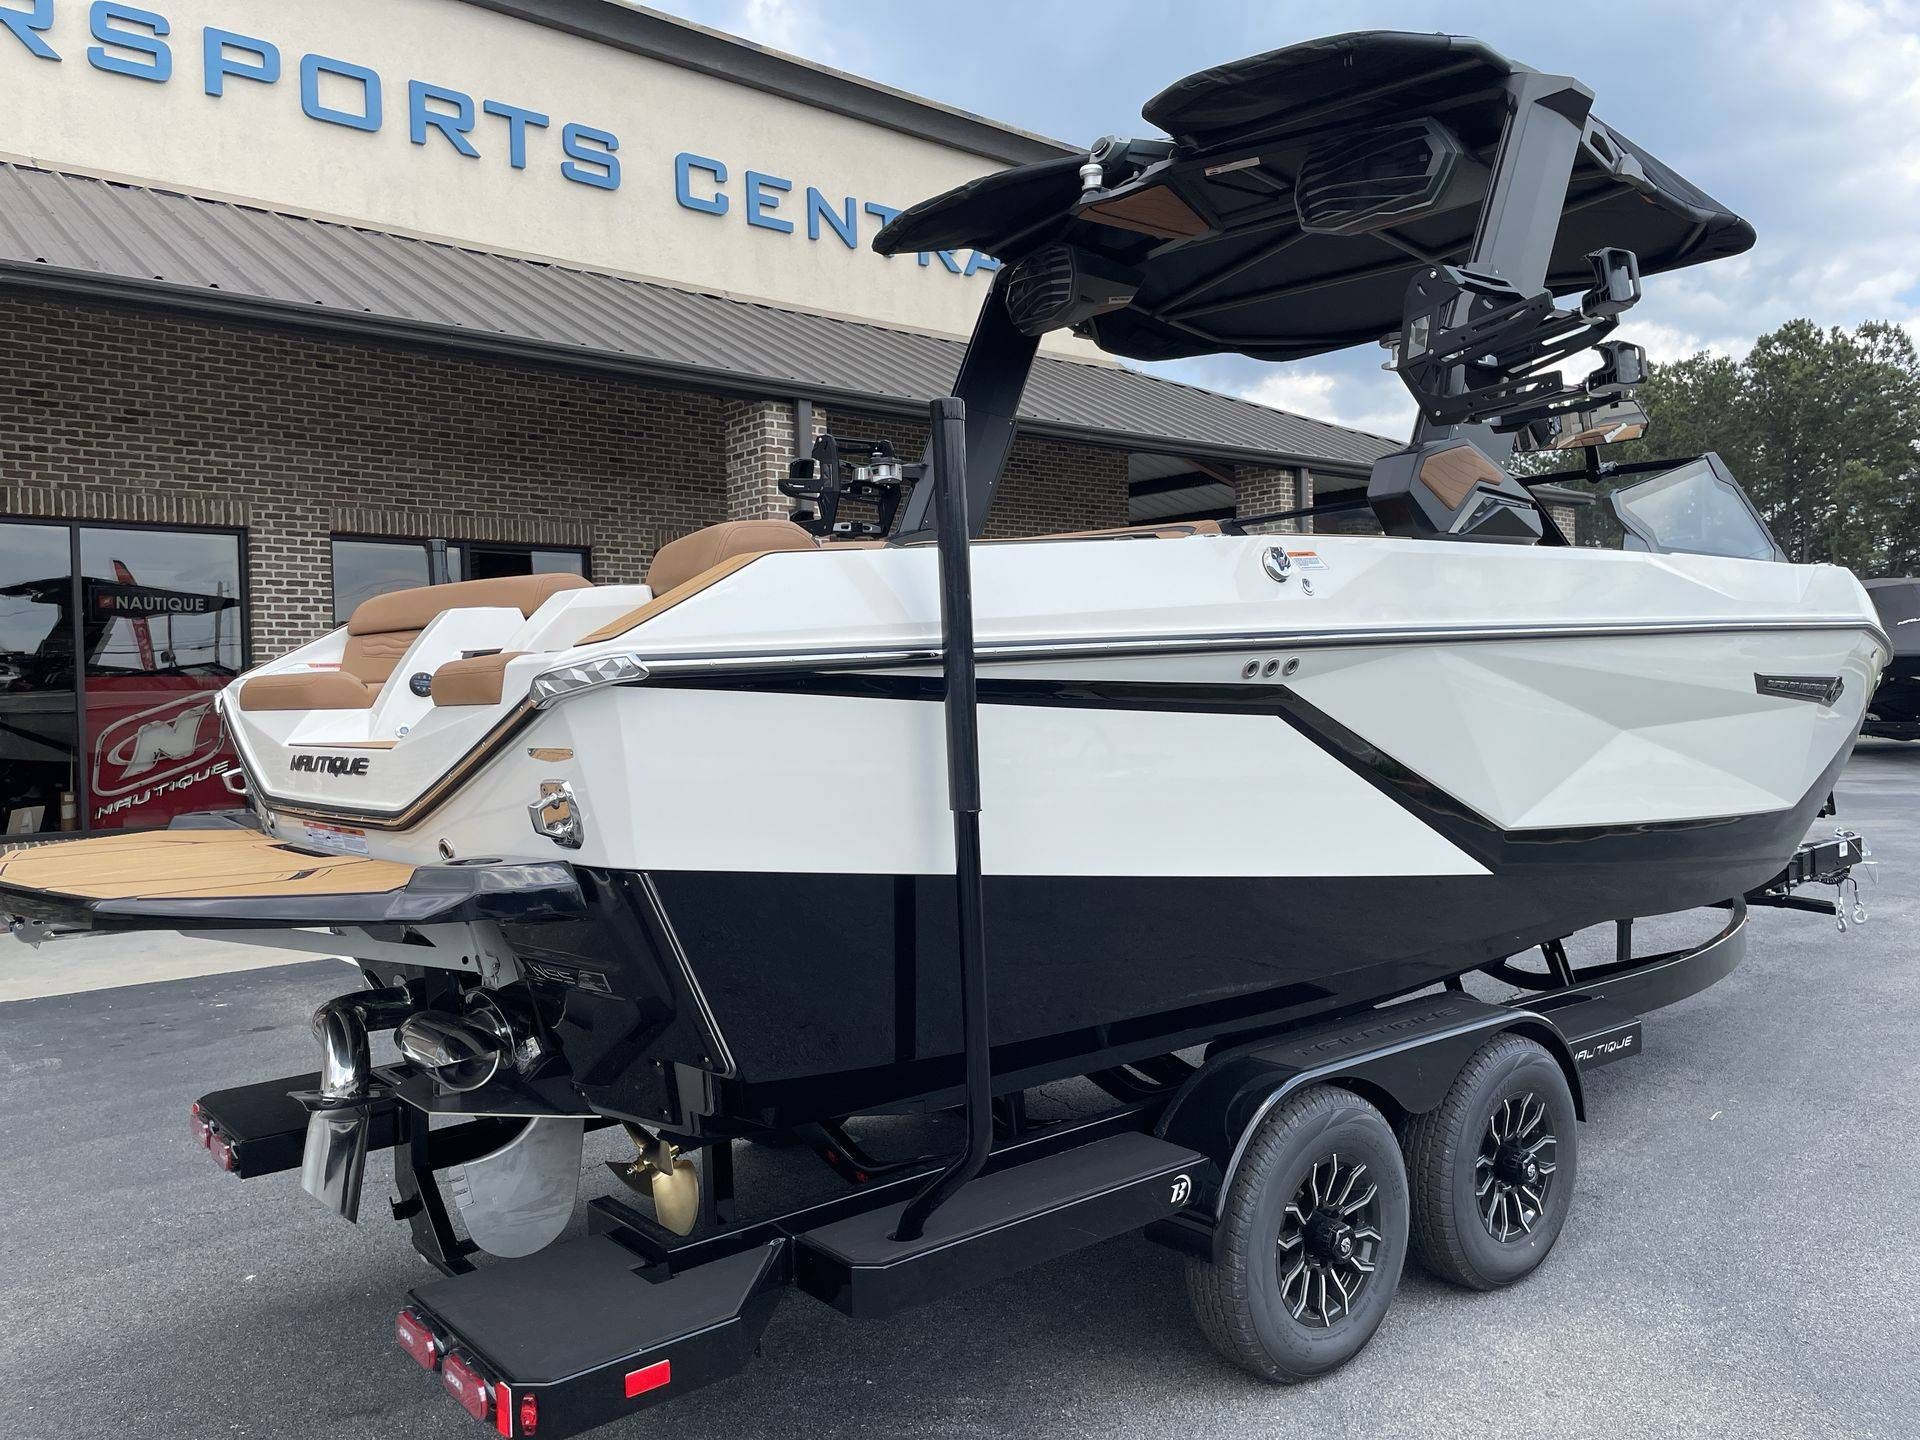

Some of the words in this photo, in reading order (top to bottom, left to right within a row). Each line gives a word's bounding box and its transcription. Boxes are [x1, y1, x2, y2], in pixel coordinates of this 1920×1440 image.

[116, 595, 205, 612] NAUTIQUE
[290, 754, 370, 777] NAUTIQUE
[94, 760, 229, 820] NAUTIQUE
